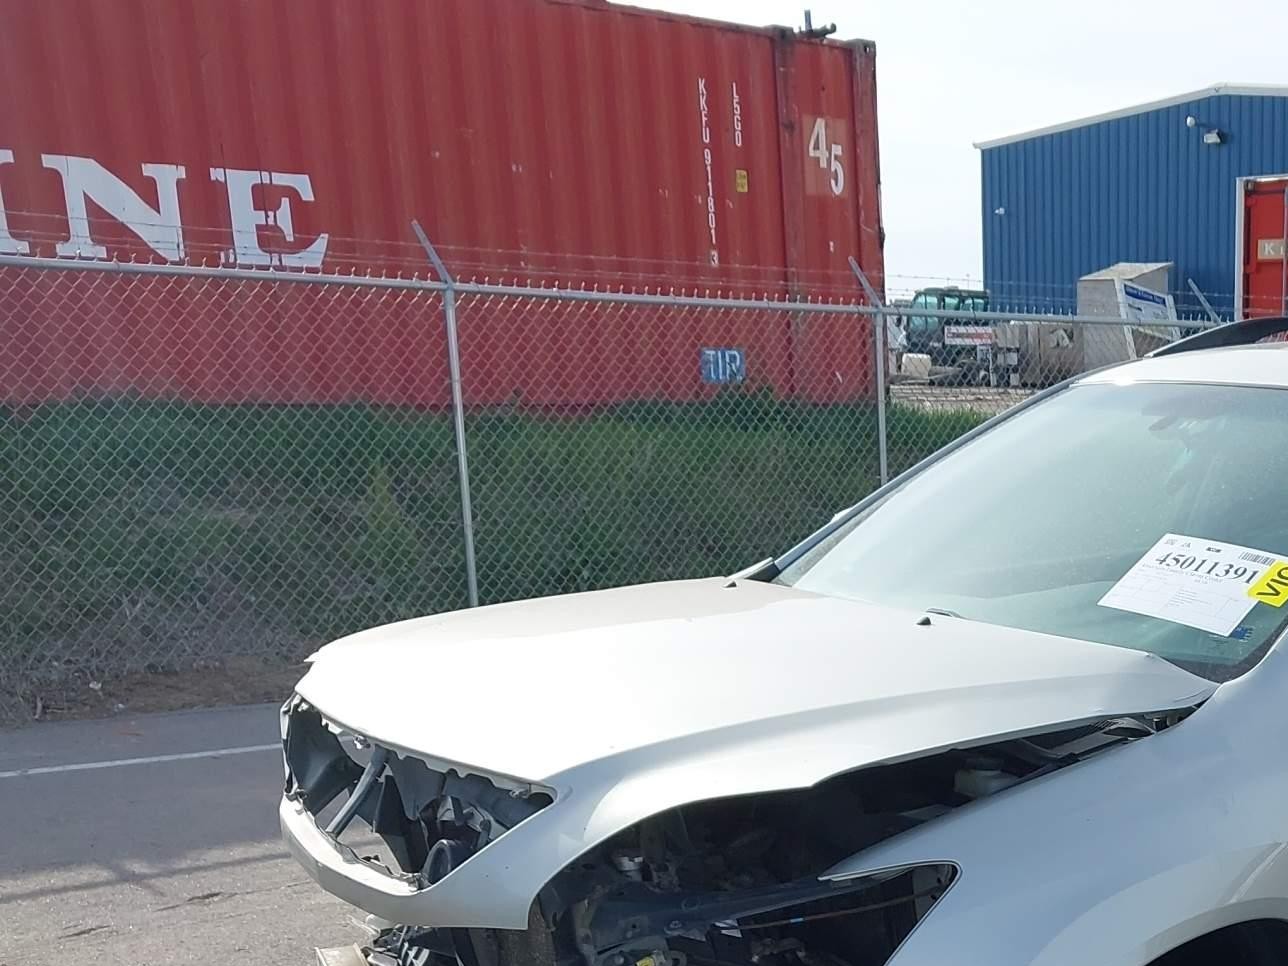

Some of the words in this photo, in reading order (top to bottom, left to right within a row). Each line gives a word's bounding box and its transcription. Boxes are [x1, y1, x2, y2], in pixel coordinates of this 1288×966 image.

[698, 77, 710, 143] KKFU
[808, 118, 844, 195] 45
[704, 350, 743, 380] TIR
[1155, 552, 1260, 584] 45011391
